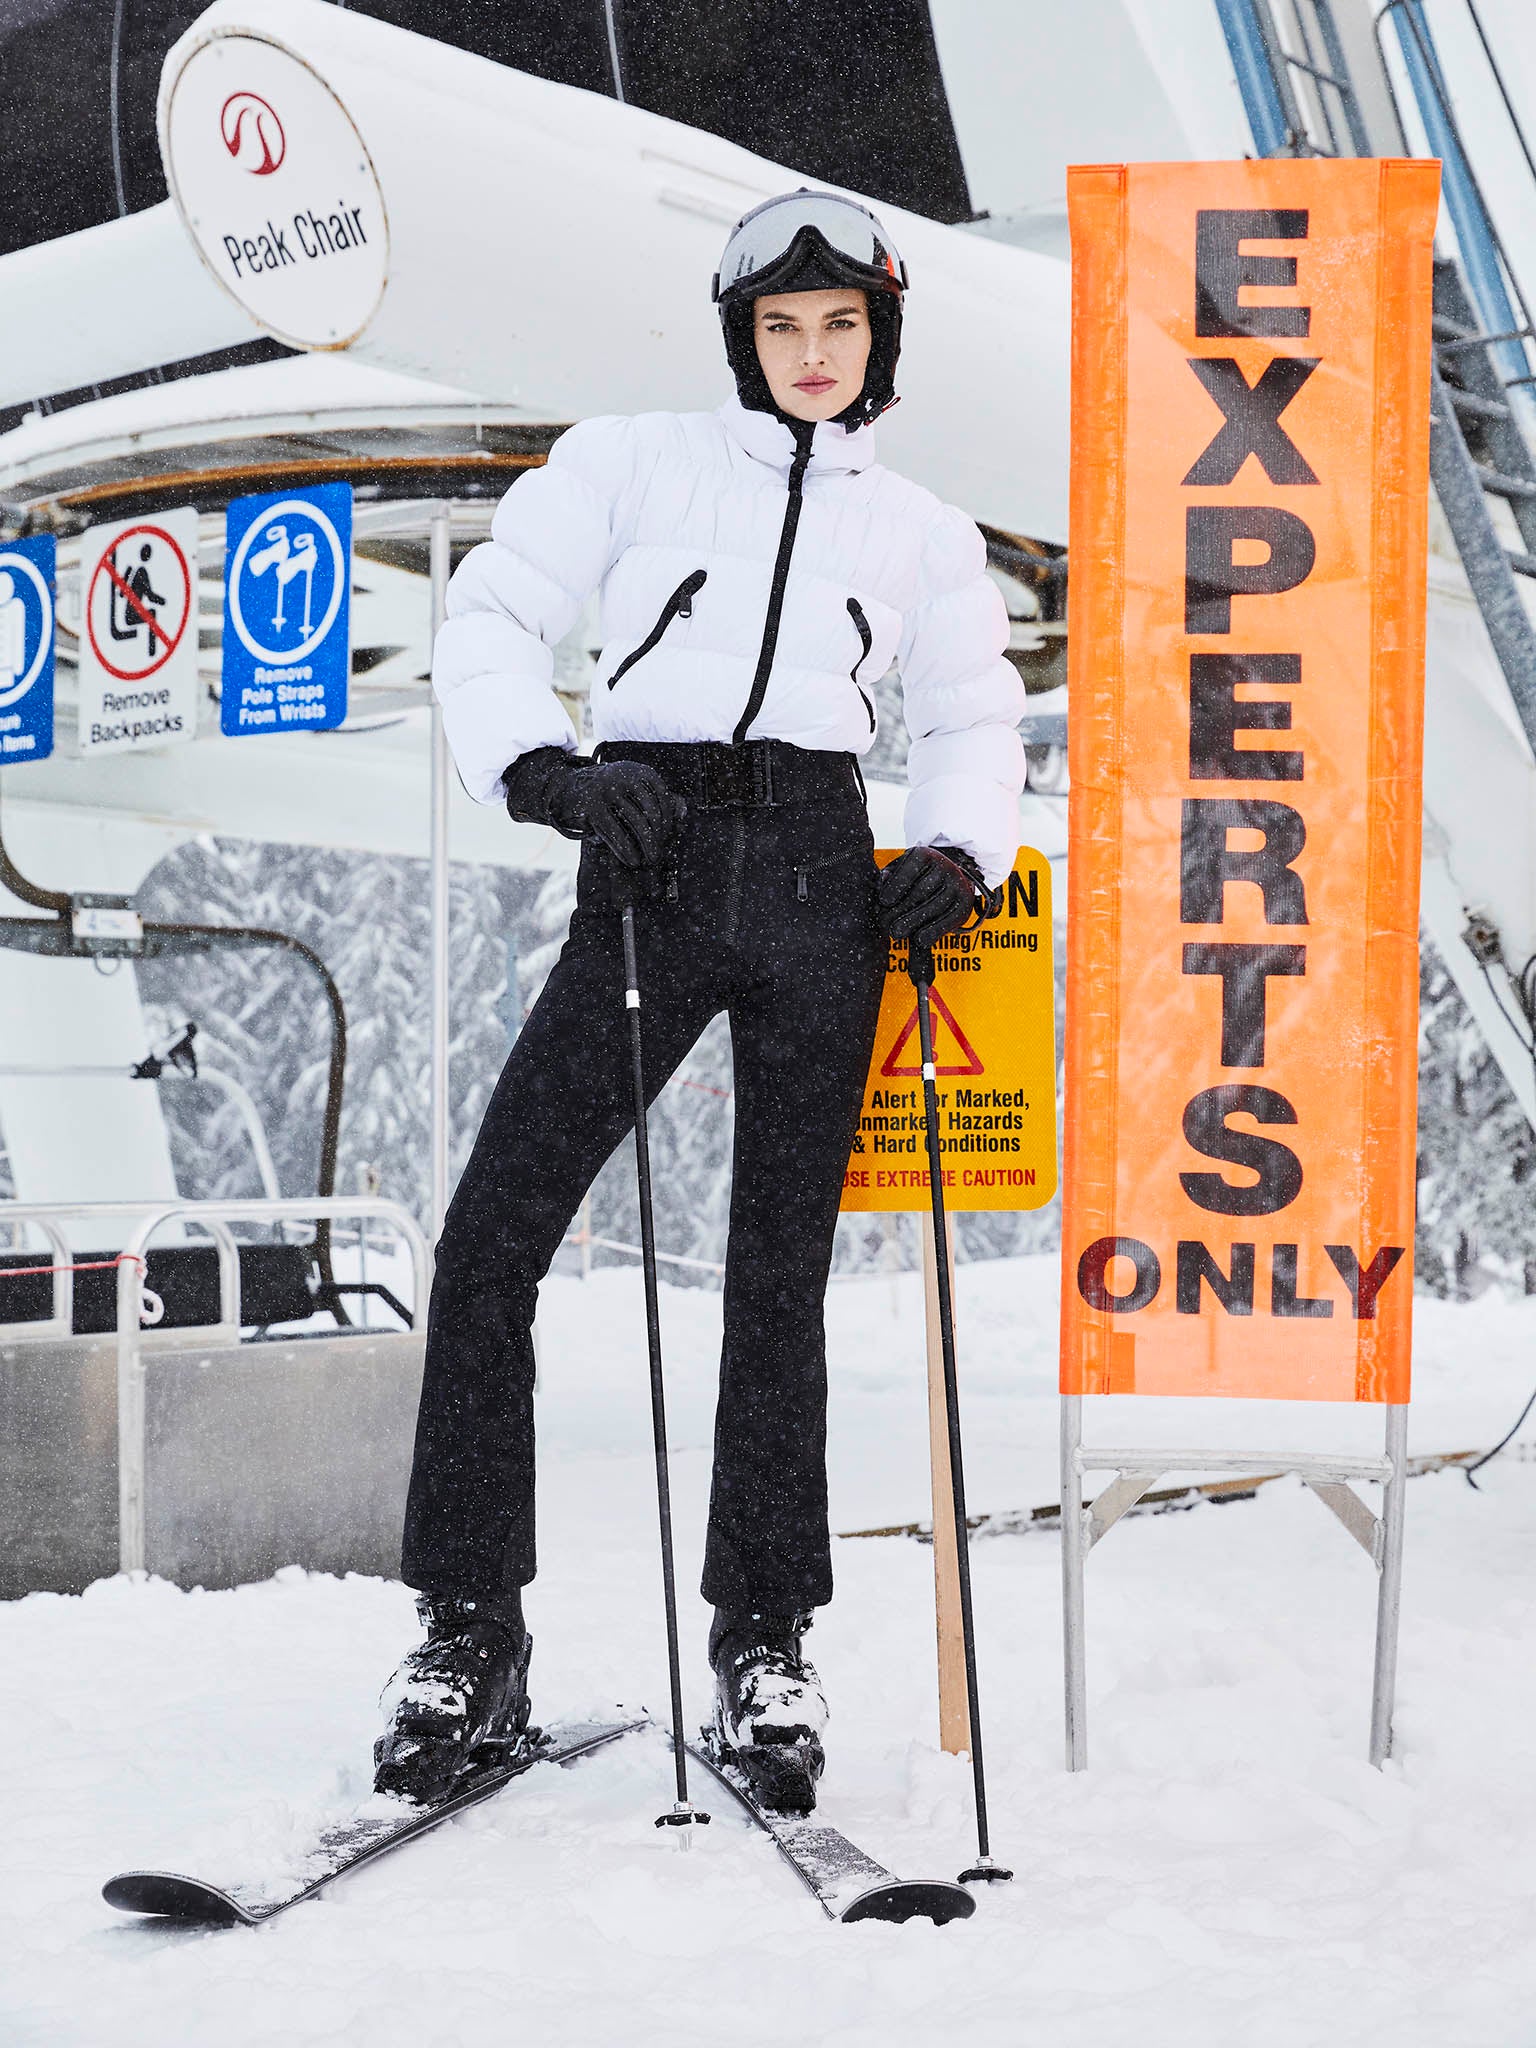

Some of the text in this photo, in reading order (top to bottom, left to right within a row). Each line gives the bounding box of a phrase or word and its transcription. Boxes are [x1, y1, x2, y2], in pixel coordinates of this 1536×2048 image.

[223, 200, 367, 278] Peak Chair
[254, 665, 313, 685] Remove
[103, 689, 170, 713] Remove
[241, 684, 325, 705] Pole Straps
[239, 702, 327, 725] From Wrists
[1179, 208, 1324, 1217] EXPERTS
[91, 713, 182, 743] Backpacks
[871, 1090, 917, 1109] Alert
[955, 1089, 1030, 1111] Marked,
[949, 1111, 1024, 1131] Hazards
[873, 1134, 917, 1153] Hard
[962, 1168, 1037, 1187] CAUTION
[1076, 1235, 1406, 1320] ONLY
